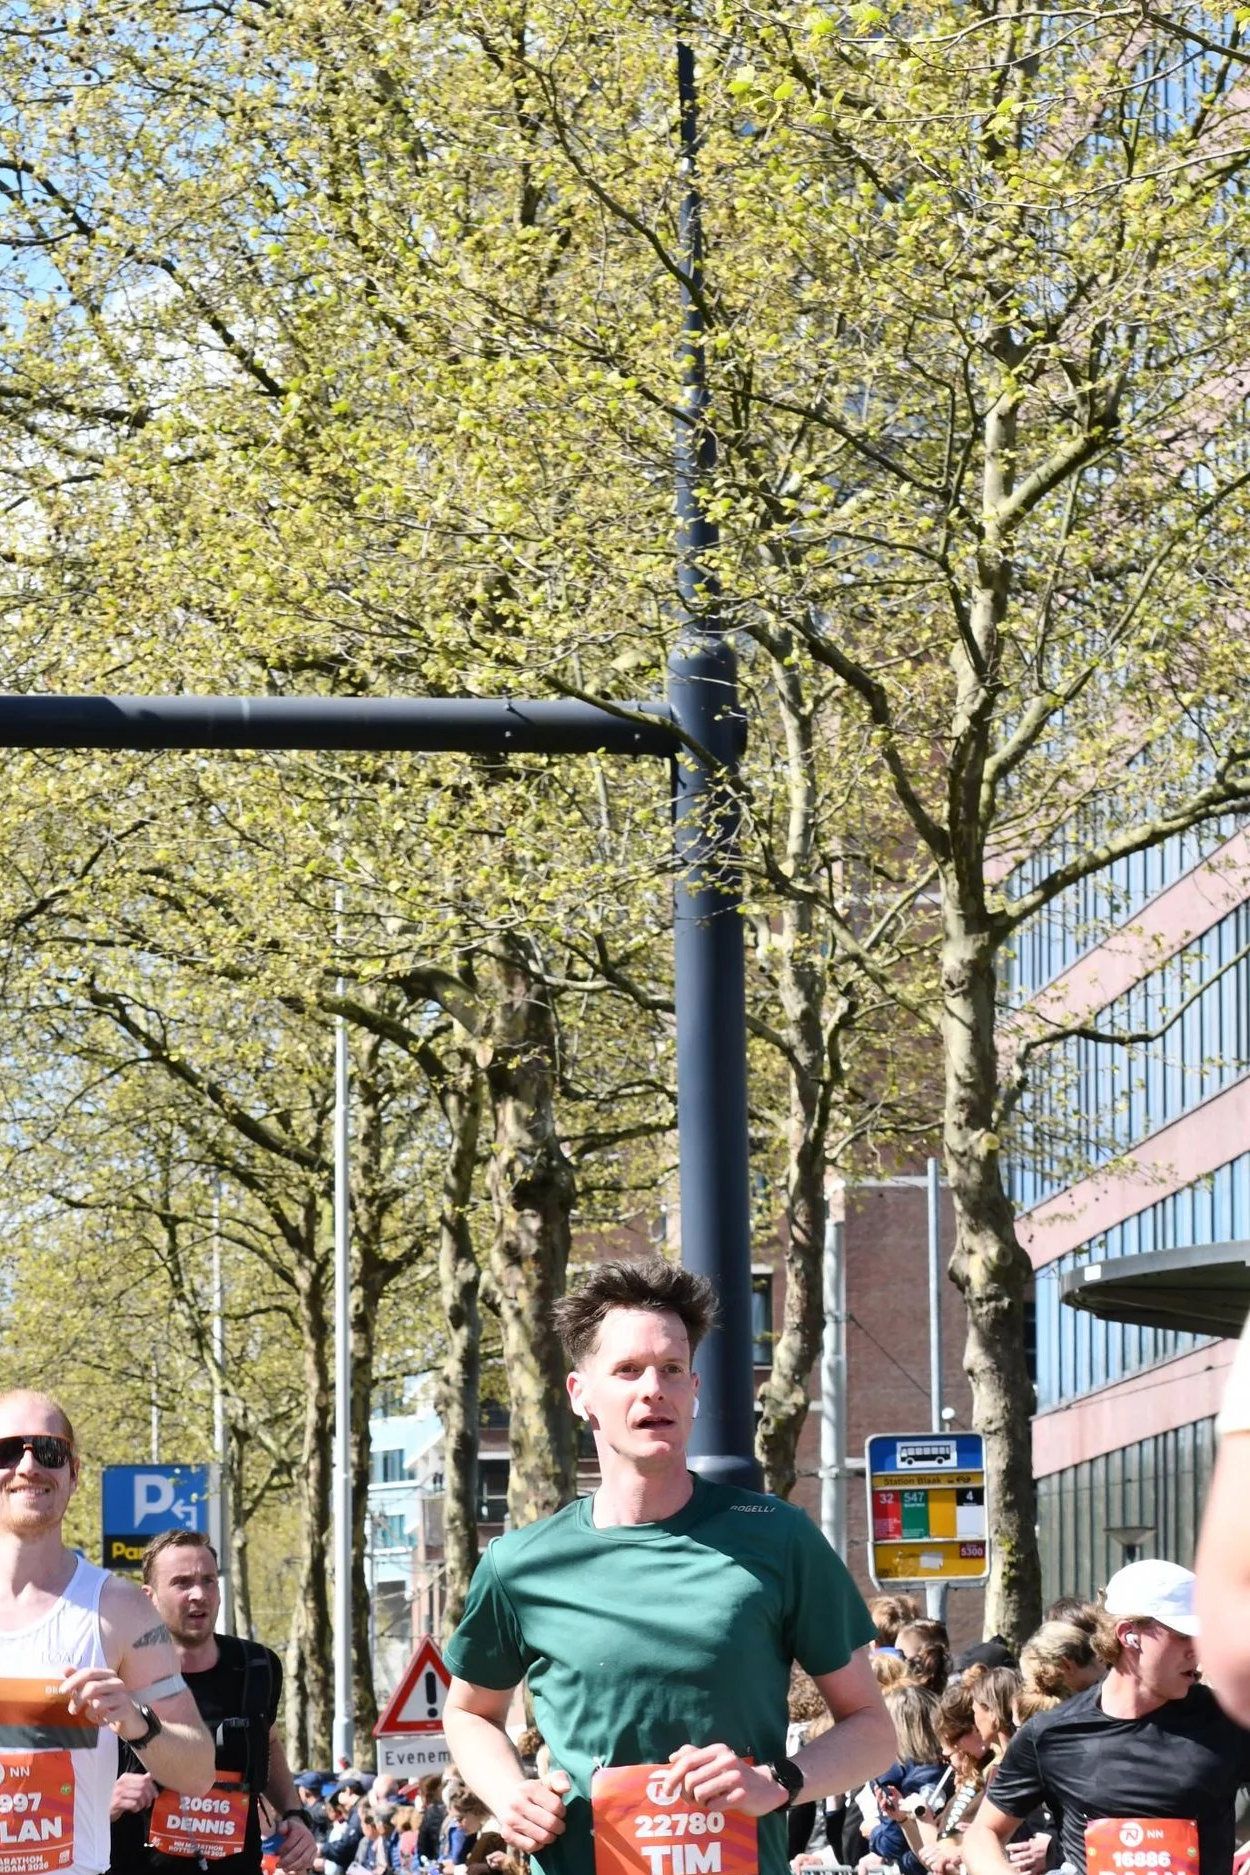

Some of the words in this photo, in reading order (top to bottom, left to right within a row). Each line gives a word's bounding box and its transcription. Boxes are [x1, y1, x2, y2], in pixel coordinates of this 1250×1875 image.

[883, 1477, 915, 1486] Station
[917, 1476, 942, 1485] Blaak
[879, 1493, 894, 1504] 32
[903, 1491, 925, 1503] 547
[965, 1490, 974, 1501] 4
[730, 1505, 776, 1513] ROGELLI
[385, 1750, 451, 1766] Evenem
[10, 1766, 30, 1777] NN
[179, 1795, 231, 1815] 20616
[166, 1814, 236, 1836] DENNIS
[634, 1811, 725, 1838] 22780
[1147, 1829, 1164, 1839] NN
